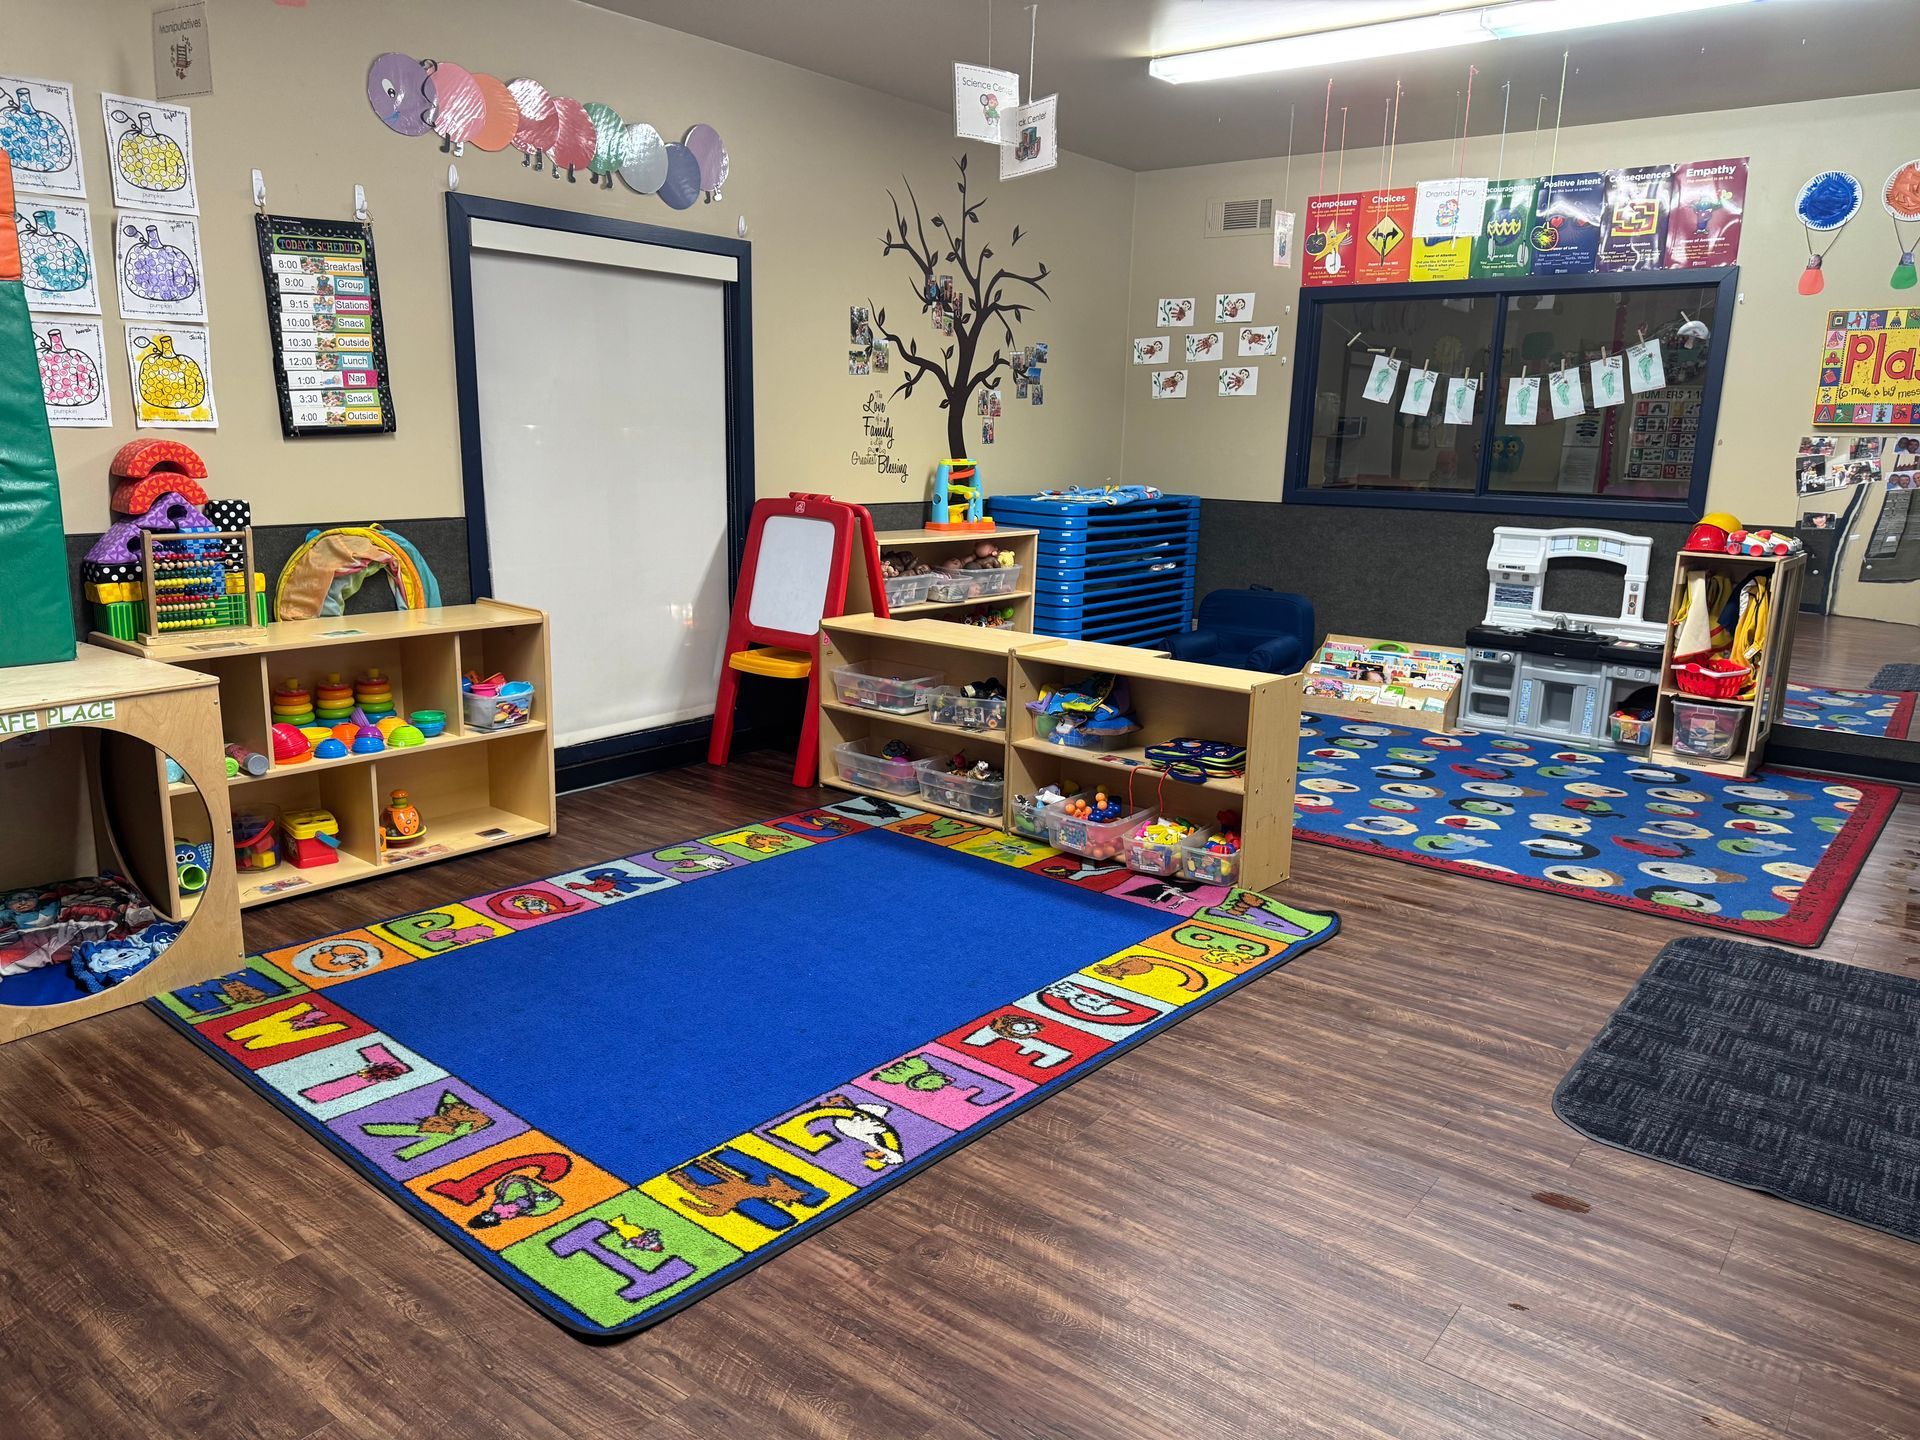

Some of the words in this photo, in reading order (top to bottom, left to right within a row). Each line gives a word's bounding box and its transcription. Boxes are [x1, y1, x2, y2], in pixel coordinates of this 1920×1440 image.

[159, 18, 201, 33] Manipulatives
[962, 77, 992, 90] Science
[992, 83, 1013, 96] Cente
[1027, 112, 1047, 125] Center
[1609, 171, 1671, 183] Consequences
[1686, 165, 1736, 177] Empathy
[1486, 184, 1537, 194] ncouragement
[1544, 178, 1576, 189] Positive
[1577, 177, 1602, 186] Intent
[142, 192, 165, 201] pumpkin
[1372, 195, 1406, 204] Choices
[1425, 189, 1459, 198] Dramatic
[1461, 188, 1477, 197] Play
[1311, 199, 1357, 209] Composure
[280, 238, 314, 250] TODAY'S
[316, 240, 361, 254] SCHEDULE
[278, 260, 297, 269] 8:00
[324, 262, 363, 272] Breakfast
[285, 278, 304, 287] 9:00
[337, 279, 364, 290] Group
[150, 303, 172, 311] pumpkin
[290, 300, 309, 309] 9:15
[336, 300, 369, 310] Stations
[287, 319, 310, 328] 10:00
[338, 319, 364, 329] Snack
[288, 338, 312, 347] 10:30
[338, 338, 370, 347] Outside
[288, 357, 312, 366] 12:00
[342, 356, 367, 366] Lunch
[297, 376, 316, 385] 1:00
[348, 374, 365, 384] Nap
[299, 394, 318, 403] 3:30
[347, 394, 373, 404] Snack
[1637, 390, 1683, 399] NUMERS
[1839, 388, 1849, 399] to
[1851, 387, 1871, 398] make
[1882, 386, 1897, 397] big
[862, 393, 886, 414] Love
[53, 407, 78, 416] pumpkin
[300, 412, 317, 422] 4:00
[347, 411, 379, 421] Outside
[862, 416, 894, 449] Family
[877, 455, 909, 483] Blessing
[47, 700, 114, 724] PLACE
[1411, 852, 1451, 866] AND
[1458, 862, 1499, 876] RED
[1522, 876, 1585, 894] WORLD
[291, 938, 383, 978] O
[380, 911, 457, 953] P
[486, 888, 584, 921] Q
[581, 867, 666, 895] R
[652, 845, 720, 875] S
[707, 829, 780, 854] T
[1592, 889, 1635, 906] THE
[1643, 902, 1670, 912] OF
[1204, 900, 1313, 937] A
[1171, 923, 1271, 961] B
[1096, 954, 1209, 992] C
[1037, 980, 1164, 1027] D
[224, 1001, 352, 1051] M
[298, 1042, 414, 1104] L
[960, 1022, 1074, 1069] E
[868, 1052, 1016, 1107] F
[359, 1089, 497, 1162] K
[763, 1102, 906, 1166] G
[427, 1152, 573, 1207] J
[668, 1145, 832, 1231] H
[547, 1218, 698, 1303] I
